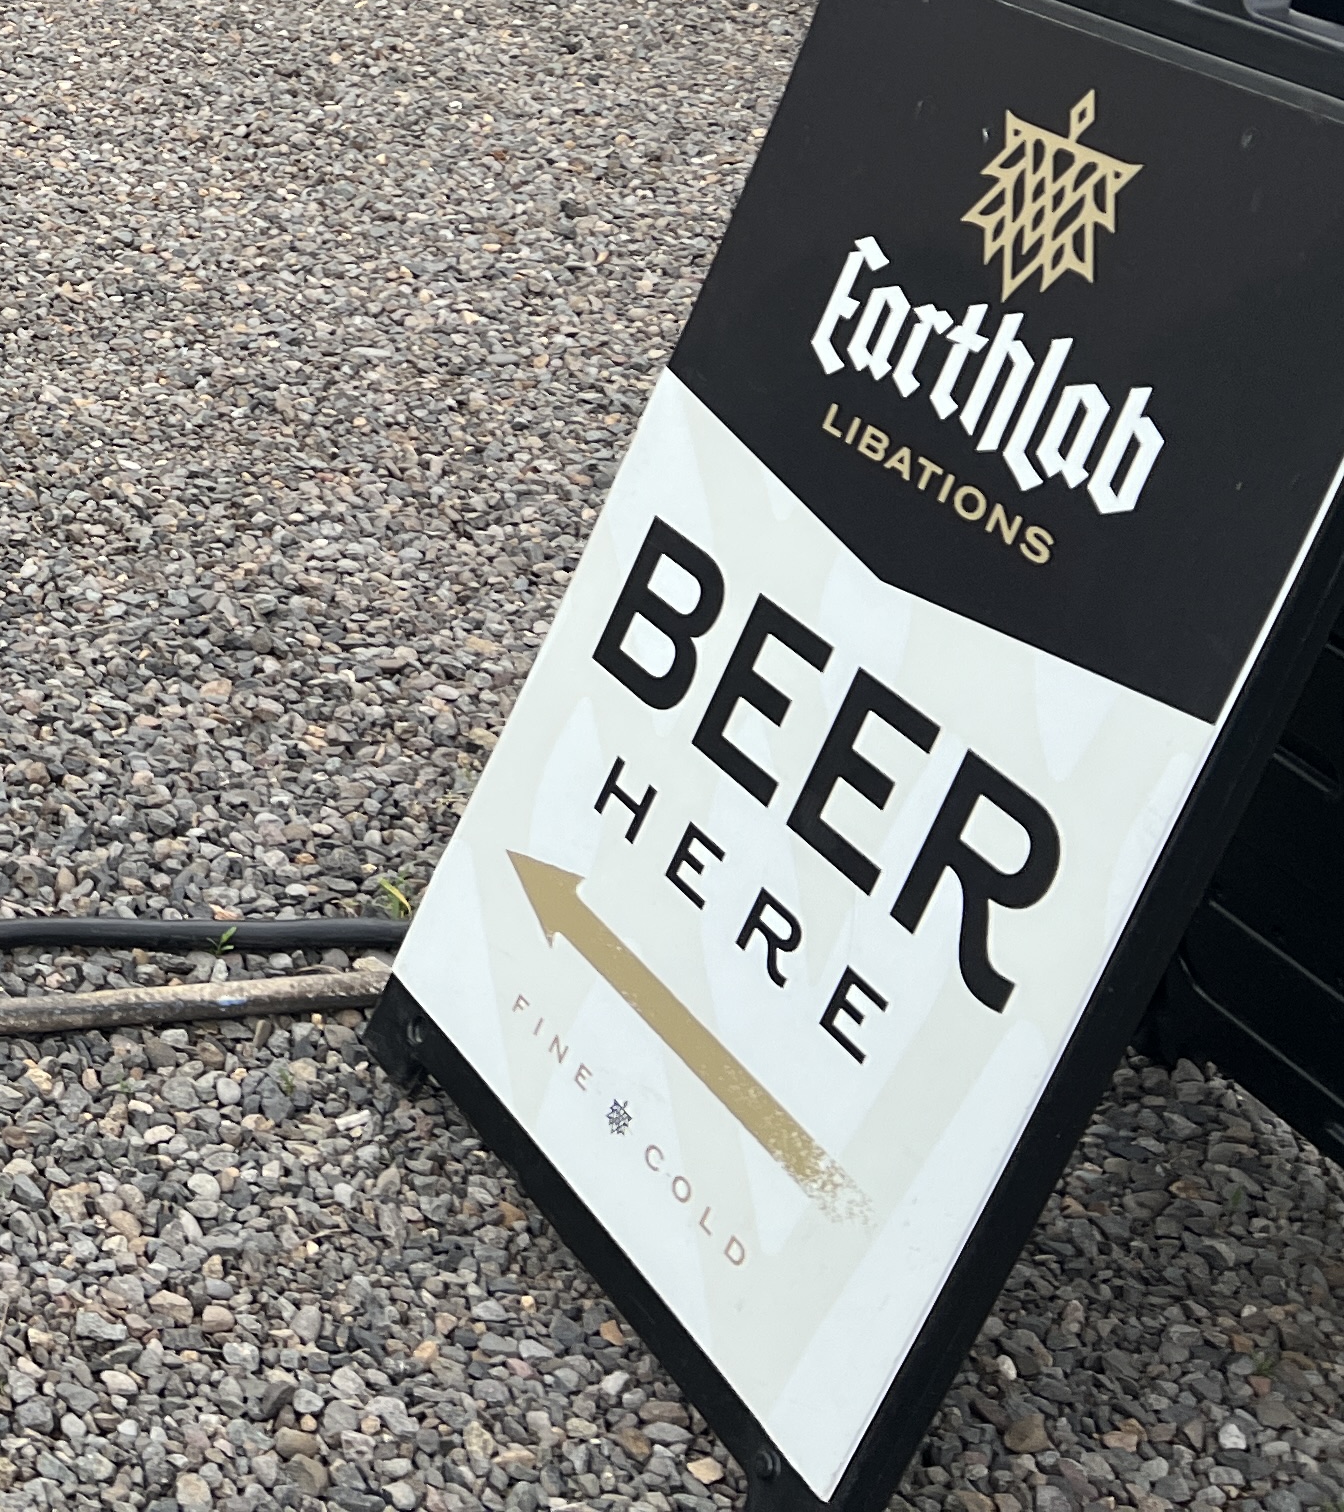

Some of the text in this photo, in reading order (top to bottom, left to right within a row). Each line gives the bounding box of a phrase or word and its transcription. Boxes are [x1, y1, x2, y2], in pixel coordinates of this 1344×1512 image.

[821, 405, 1054, 566] LIBATIONS
[593, 515, 1060, 1014] BEER
[594, 758, 889, 1064] HERE
[512, 994, 745, 1266] FINE COLD
